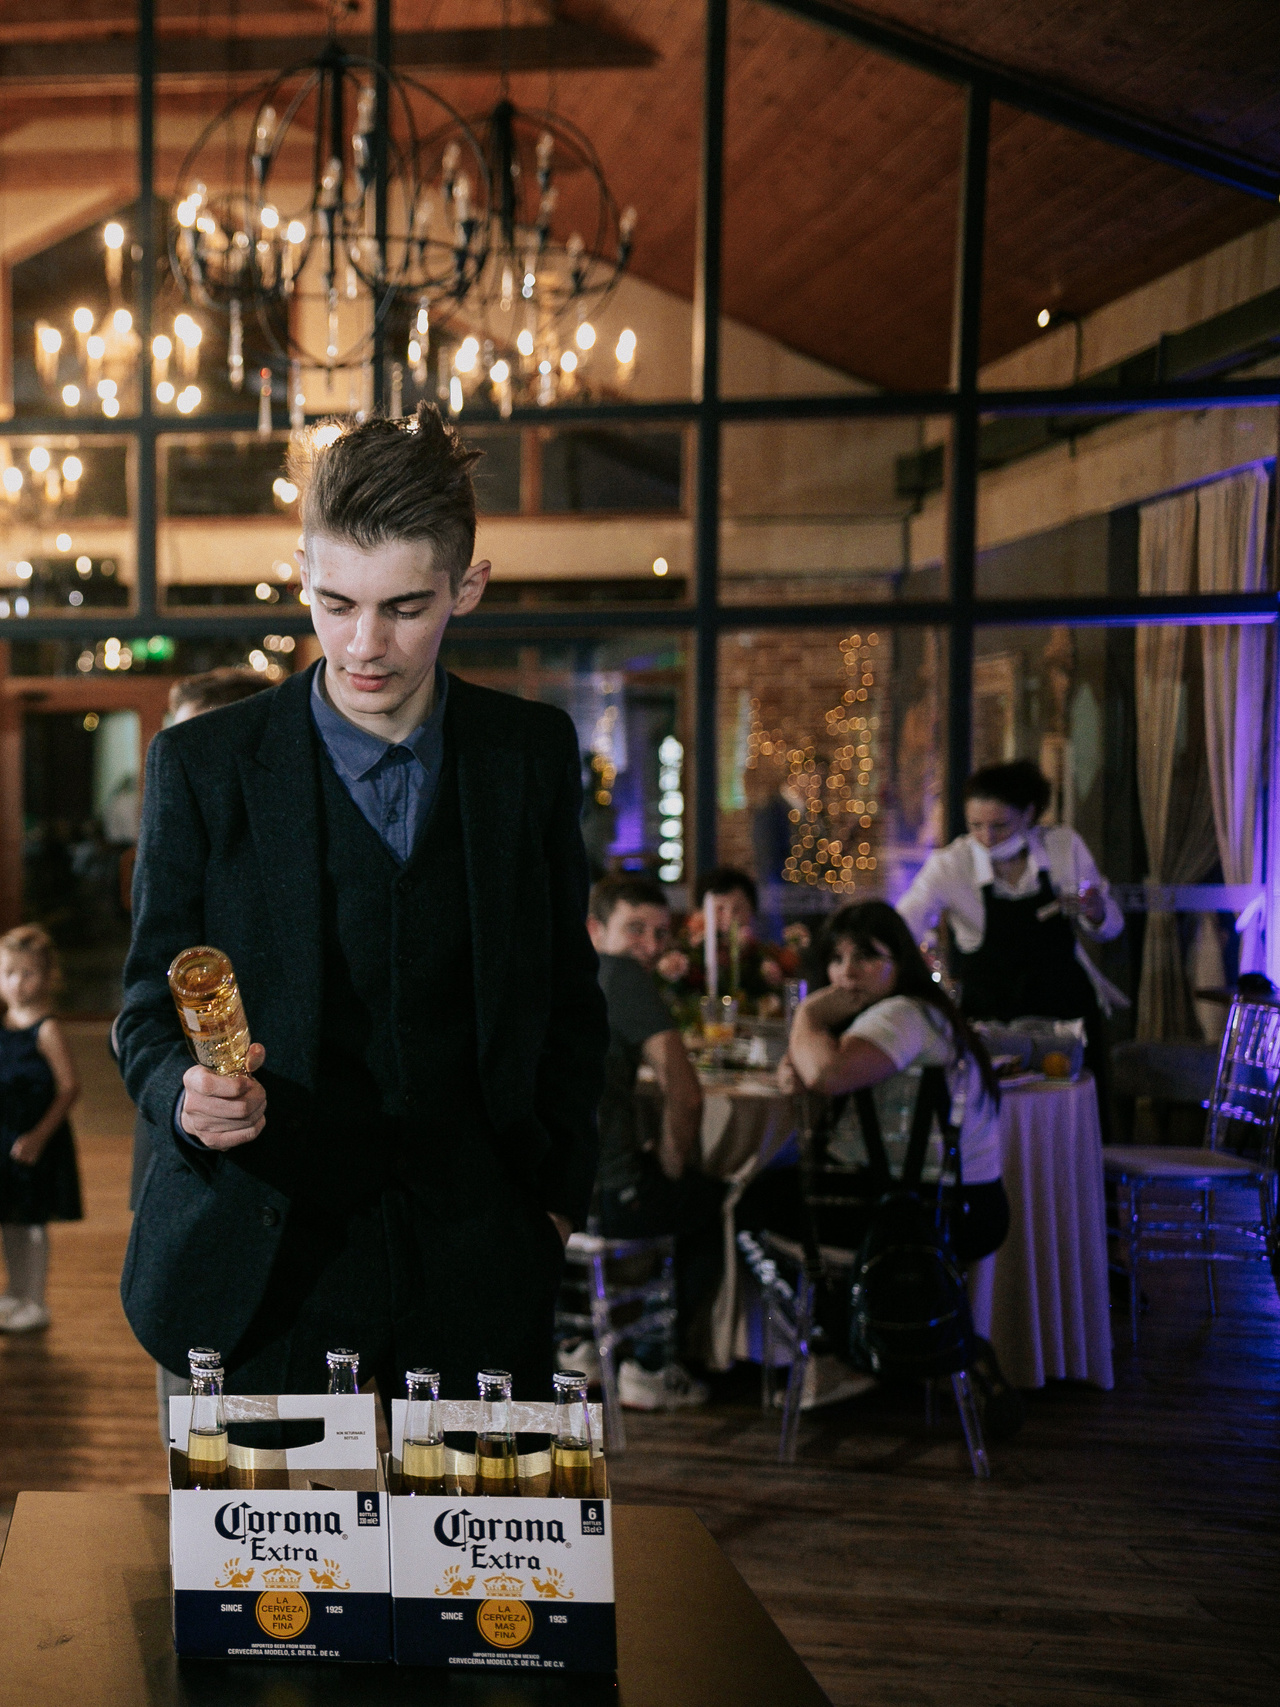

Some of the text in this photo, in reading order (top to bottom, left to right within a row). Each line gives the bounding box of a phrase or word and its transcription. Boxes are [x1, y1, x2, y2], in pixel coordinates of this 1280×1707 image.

[364, 1499, 373, 1511] 6
[588, 1507, 597, 1520] 6
[214, 1501, 344, 1545] Corona
[433, 1508, 567, 1552] Corona
[250, 1537, 318, 1562] Extra
[471, 1544, 541, 1570] Extra
[221, 1604, 242, 1612] SINCE
[261, 1605, 305, 1613] CERVEZA
[441, 1612, 567, 1623] SINCE 1925
[483, 1613, 527, 1622] CERVEZA
[272, 1622, 294, 1630] FINA
[495, 1623, 516, 1631] MAS
[494, 1631, 517, 1639] FINA
[227, 1648, 263, 1656] CERVECERIA
[264, 1649, 290, 1657] MODELO,
[448, 1657, 485, 1665] CERVECERIA
[486, 1658, 513, 1667] MODELO,
[544, 1660, 553, 1668] DE
[553, 1660, 565, 1668] C.V.
